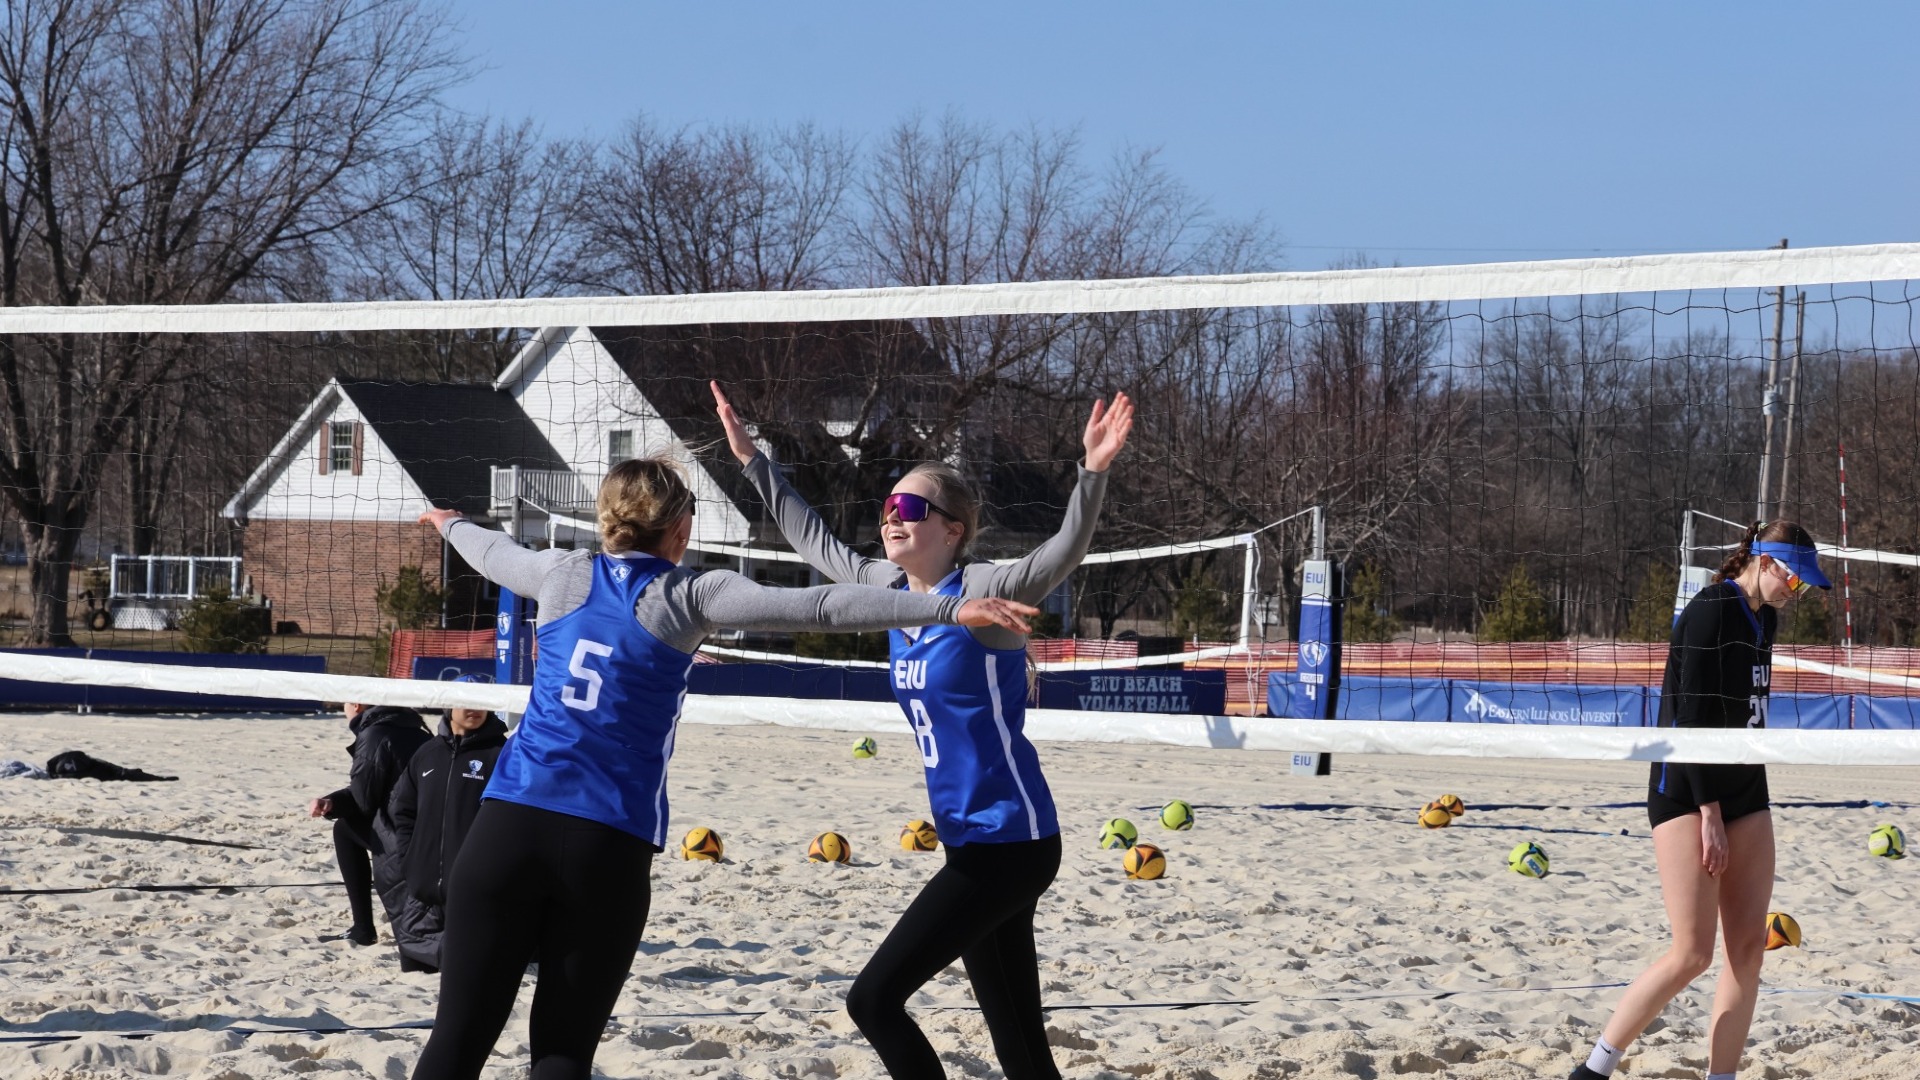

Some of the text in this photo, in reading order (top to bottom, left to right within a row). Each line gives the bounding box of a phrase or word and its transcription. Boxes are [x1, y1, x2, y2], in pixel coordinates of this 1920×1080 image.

[1305, 572, 1324, 584] EIU
[1682, 581, 1700, 593] EIU
[561, 638, 614, 711] 5
[893, 659, 928, 690] EIU
[1090, 676, 1182, 693] EIU BEACH
[1305, 684, 1316, 700] 4
[1078, 695, 1190, 712] VOLLEYBALL
[909, 698, 940, 769] 8
[1293, 755, 1312, 766] EIU
